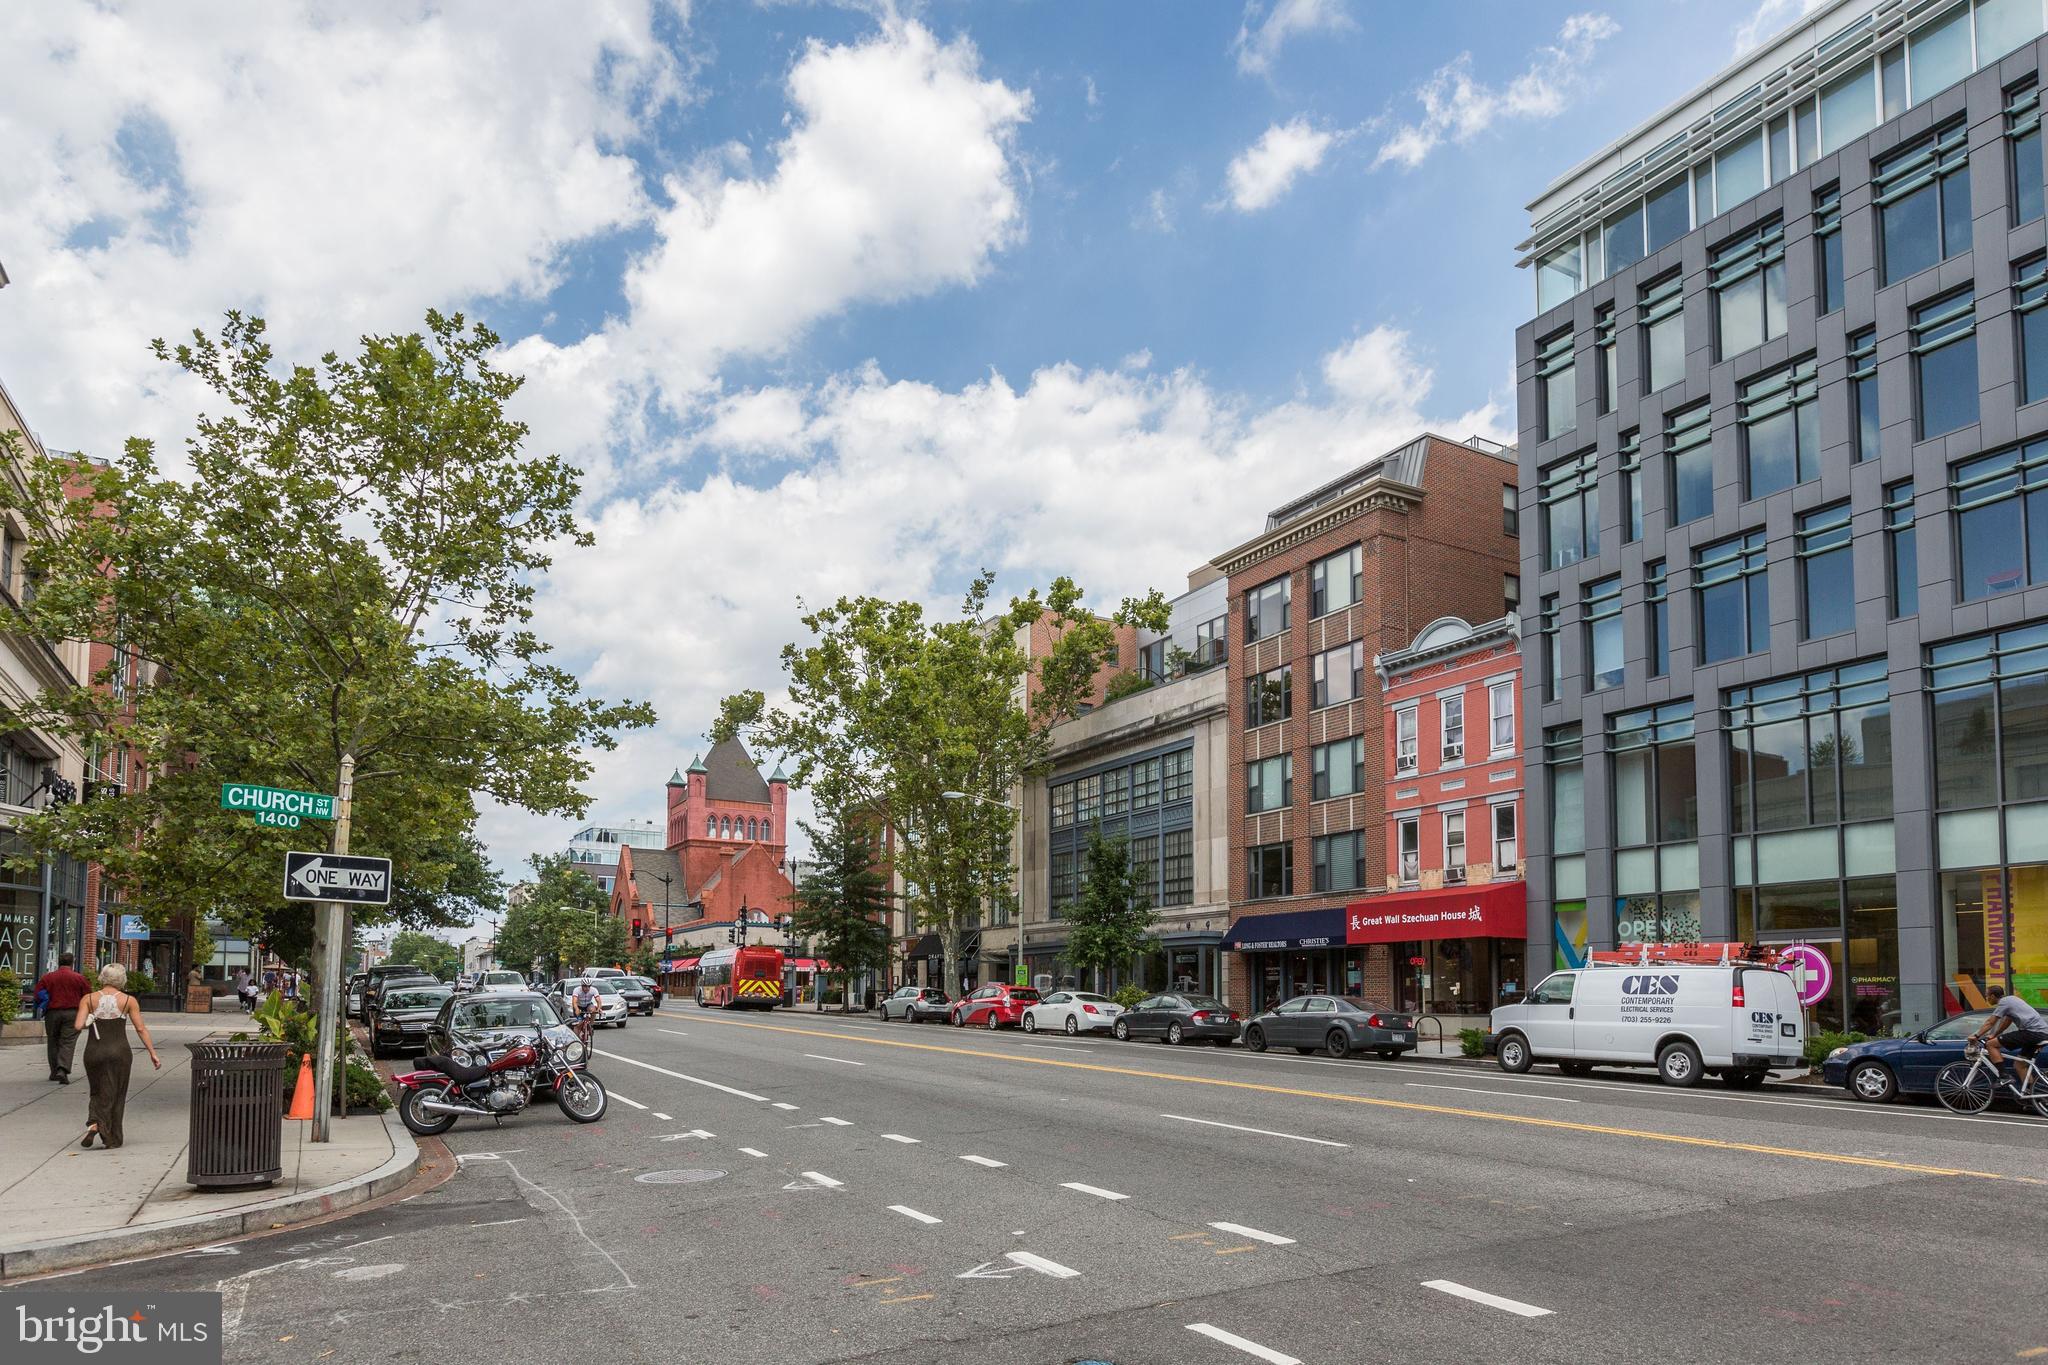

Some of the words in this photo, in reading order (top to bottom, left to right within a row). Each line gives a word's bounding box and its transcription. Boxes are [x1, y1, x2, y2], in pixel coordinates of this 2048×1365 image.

[228, 787, 313, 814] CHURCH
[316, 798, 330, 808] ST
[258, 811, 300, 828] 1400
[315, 807, 329, 816] NW
[305, 869, 338, 885] ONE
[349, 871, 383, 888] WAY
[1362, 917, 1383, 926] Great
[1384, 915, 1400, 924] Wall
[1402, 913, 1439, 923] Szechuan
[1441, 911, 1467, 921] House
[1617, 920, 1672, 937] OPEN
[0, 952, 34, 975] ALE
[1621, 974, 1680, 995] CES
[1621, 996, 1675, 1005] CONTEMPORARY
[1639, 1016, 1672, 1024] 255-9226
[1751, 1011, 1774, 1024] CES
